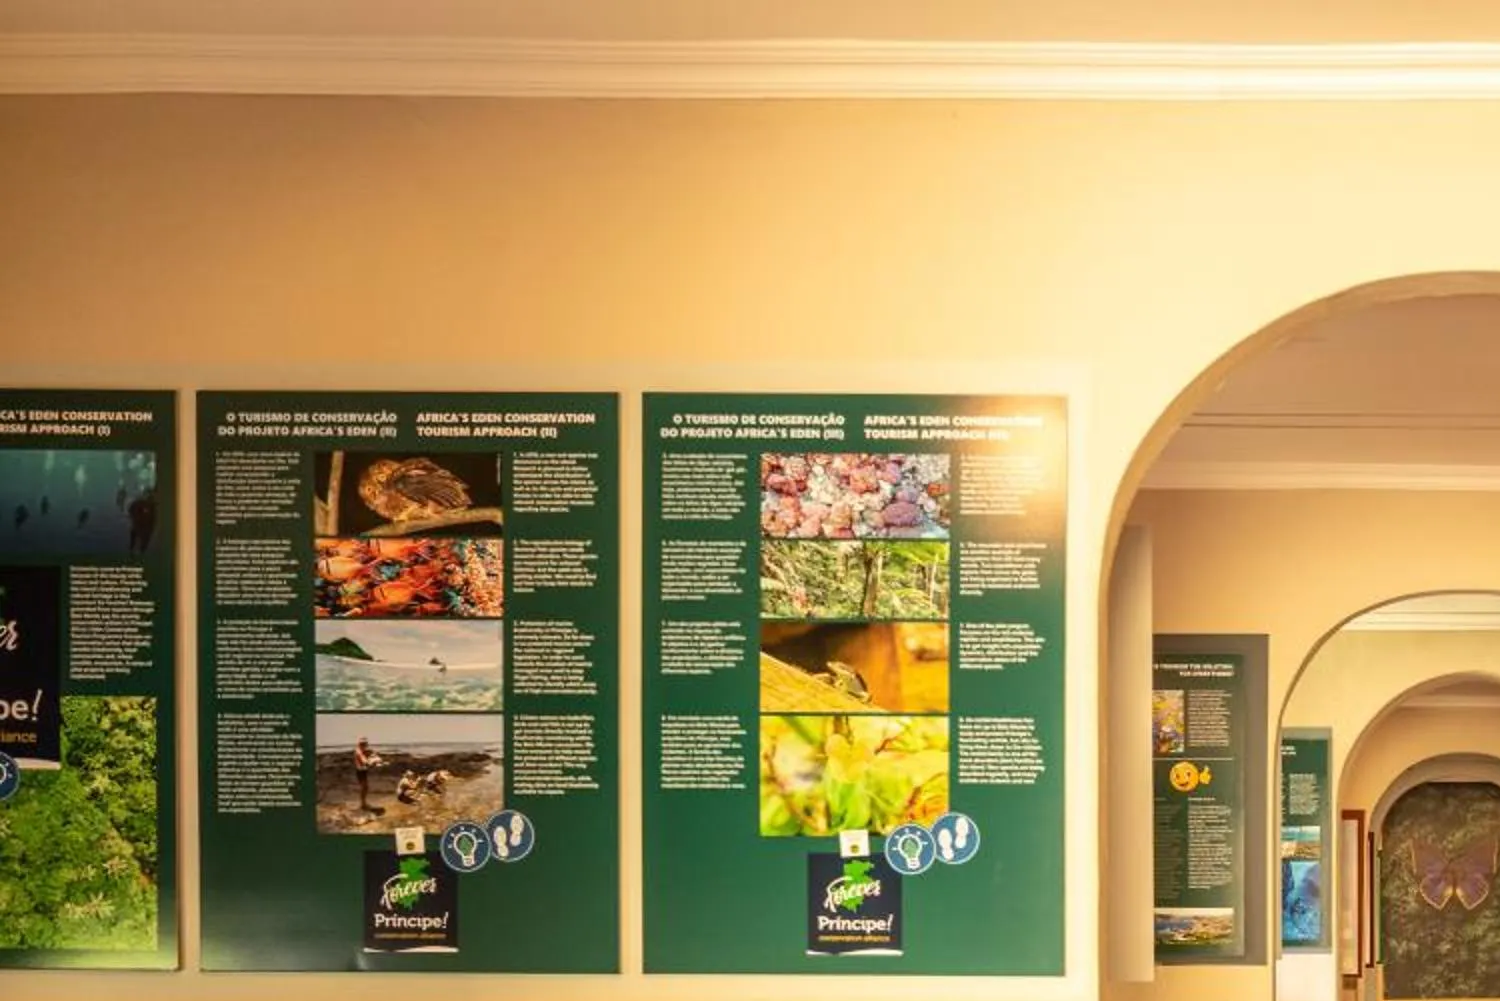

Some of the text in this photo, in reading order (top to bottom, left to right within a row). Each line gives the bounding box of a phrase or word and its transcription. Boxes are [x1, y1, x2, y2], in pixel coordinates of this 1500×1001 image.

[62, 411, 153, 422] CONSERVATION
[238, 412, 291, 423] TURISMO
[294, 412, 309, 423] DE
[312, 409, 397, 426] CONSERVAÇÃO
[416, 413, 595, 424] AFRICA'S EDEN CONSERVATION
[685, 414, 738, 425] TURISMO
[741, 414, 756, 425] DE
[759, 411, 845, 427] CONSERVAÇÃO
[864, 415, 916, 426] AFRICA'S
[919, 415, 950, 426] EDEN
[30, 424, 95, 434] APPROACH
[217, 426, 235, 436] DO
[238, 426, 289, 436] PROJETO
[292, 426, 344, 437] AFRICA'S
[347, 427, 377, 437] EDEN
[416, 427, 470, 437] TOURISM
[473, 427, 537, 438] APPROACH
[660, 427, 678, 438] DO
[681, 427, 733, 438] PROJETO
[735, 428, 787, 439] AFRICA'S
[790, 428, 820, 439] EDEN
[864, 428, 918, 439] TOURISM
